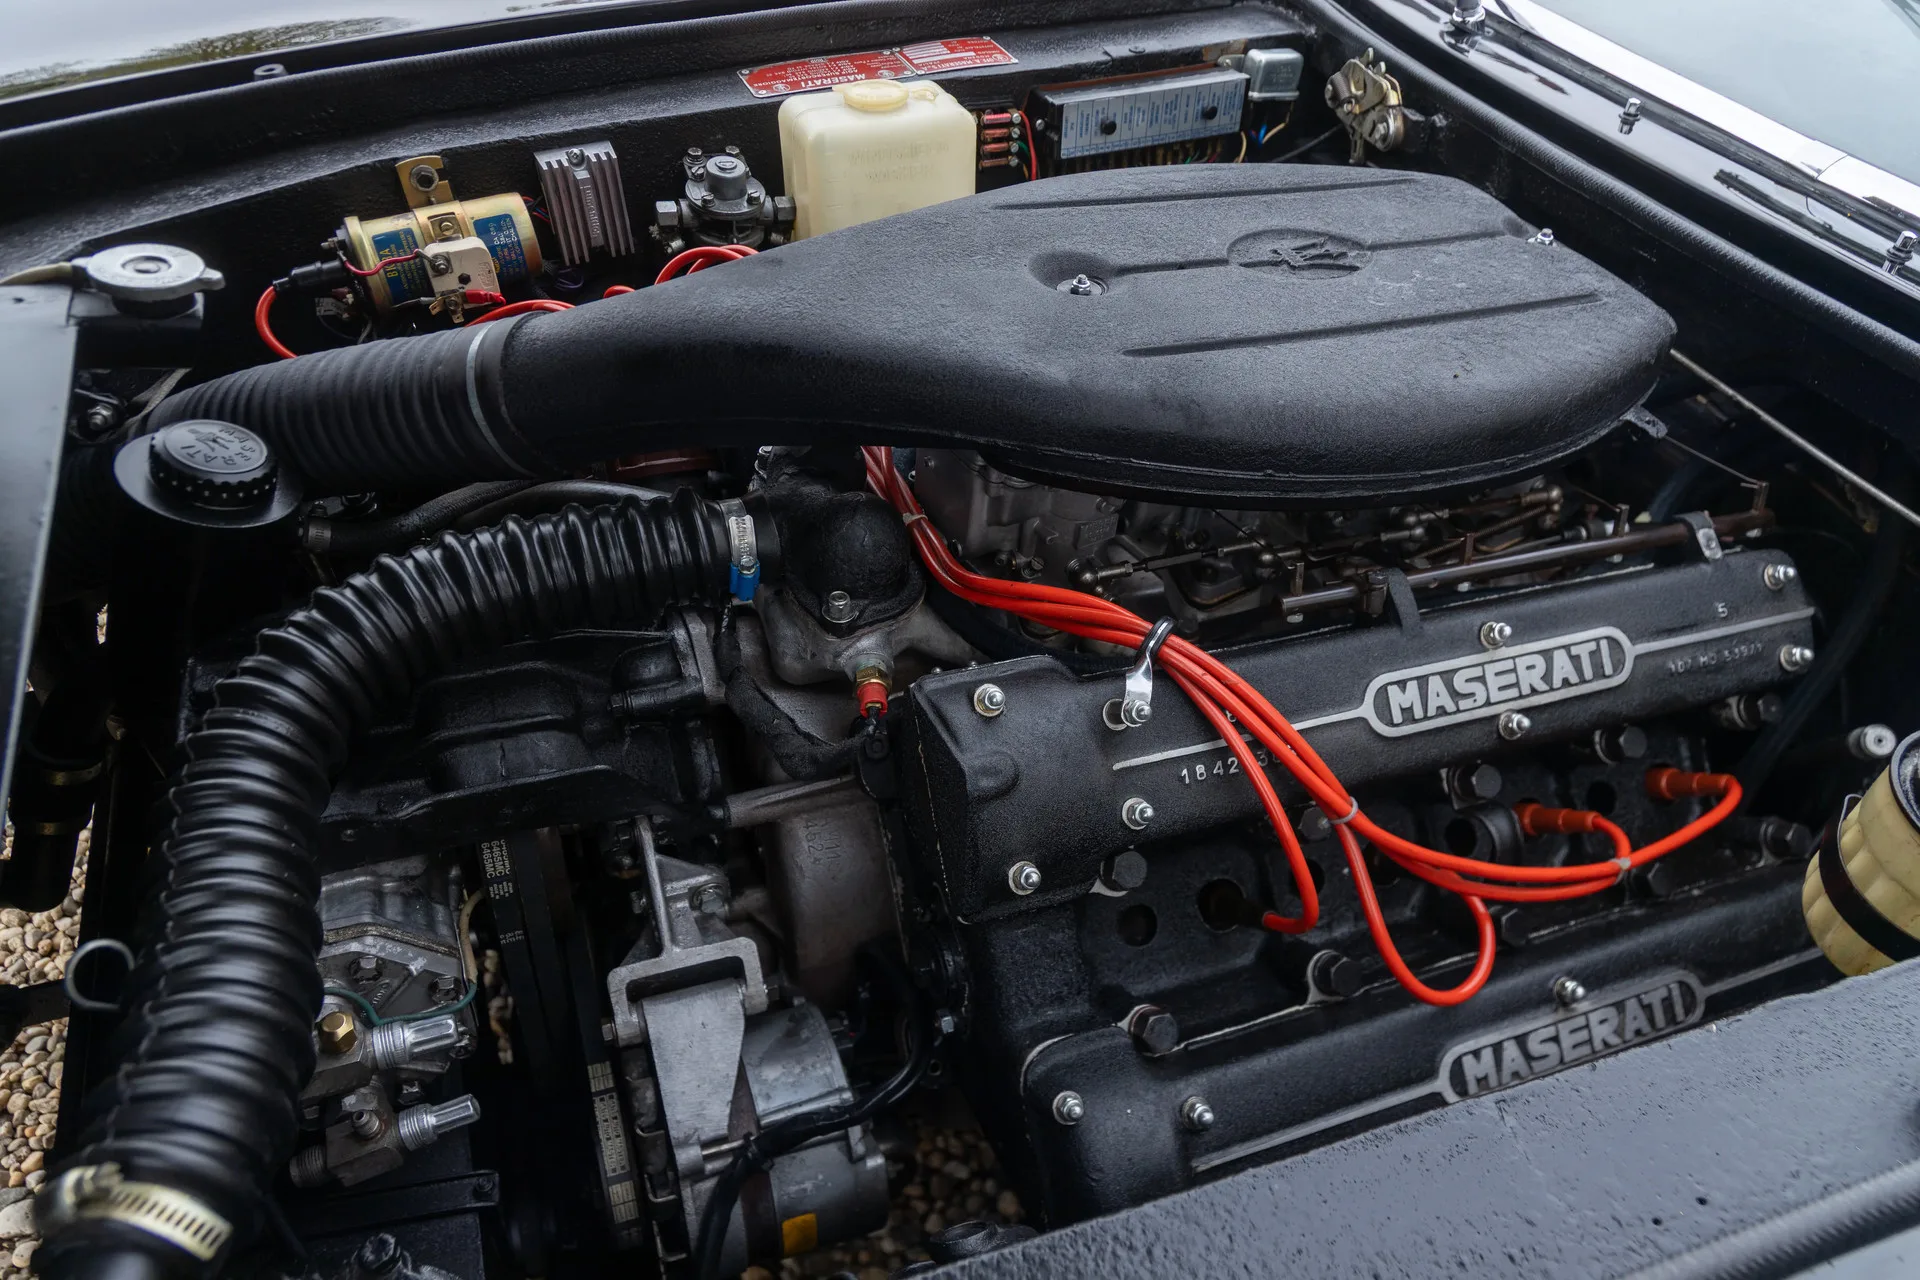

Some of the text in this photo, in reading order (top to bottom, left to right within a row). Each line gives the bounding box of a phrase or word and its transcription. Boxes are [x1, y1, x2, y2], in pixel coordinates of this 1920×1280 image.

[801, 73, 866, 88] MASERATI
[938, 59, 972, 69] MASERATI
[1717, 602, 1728, 618] 5
[1387, 638, 1614, 725] MASERATI
[481, 842, 495, 879] 6465MC
[491, 840, 504, 876] 6465MC
[1461, 983, 1685, 1095] MASERATI
